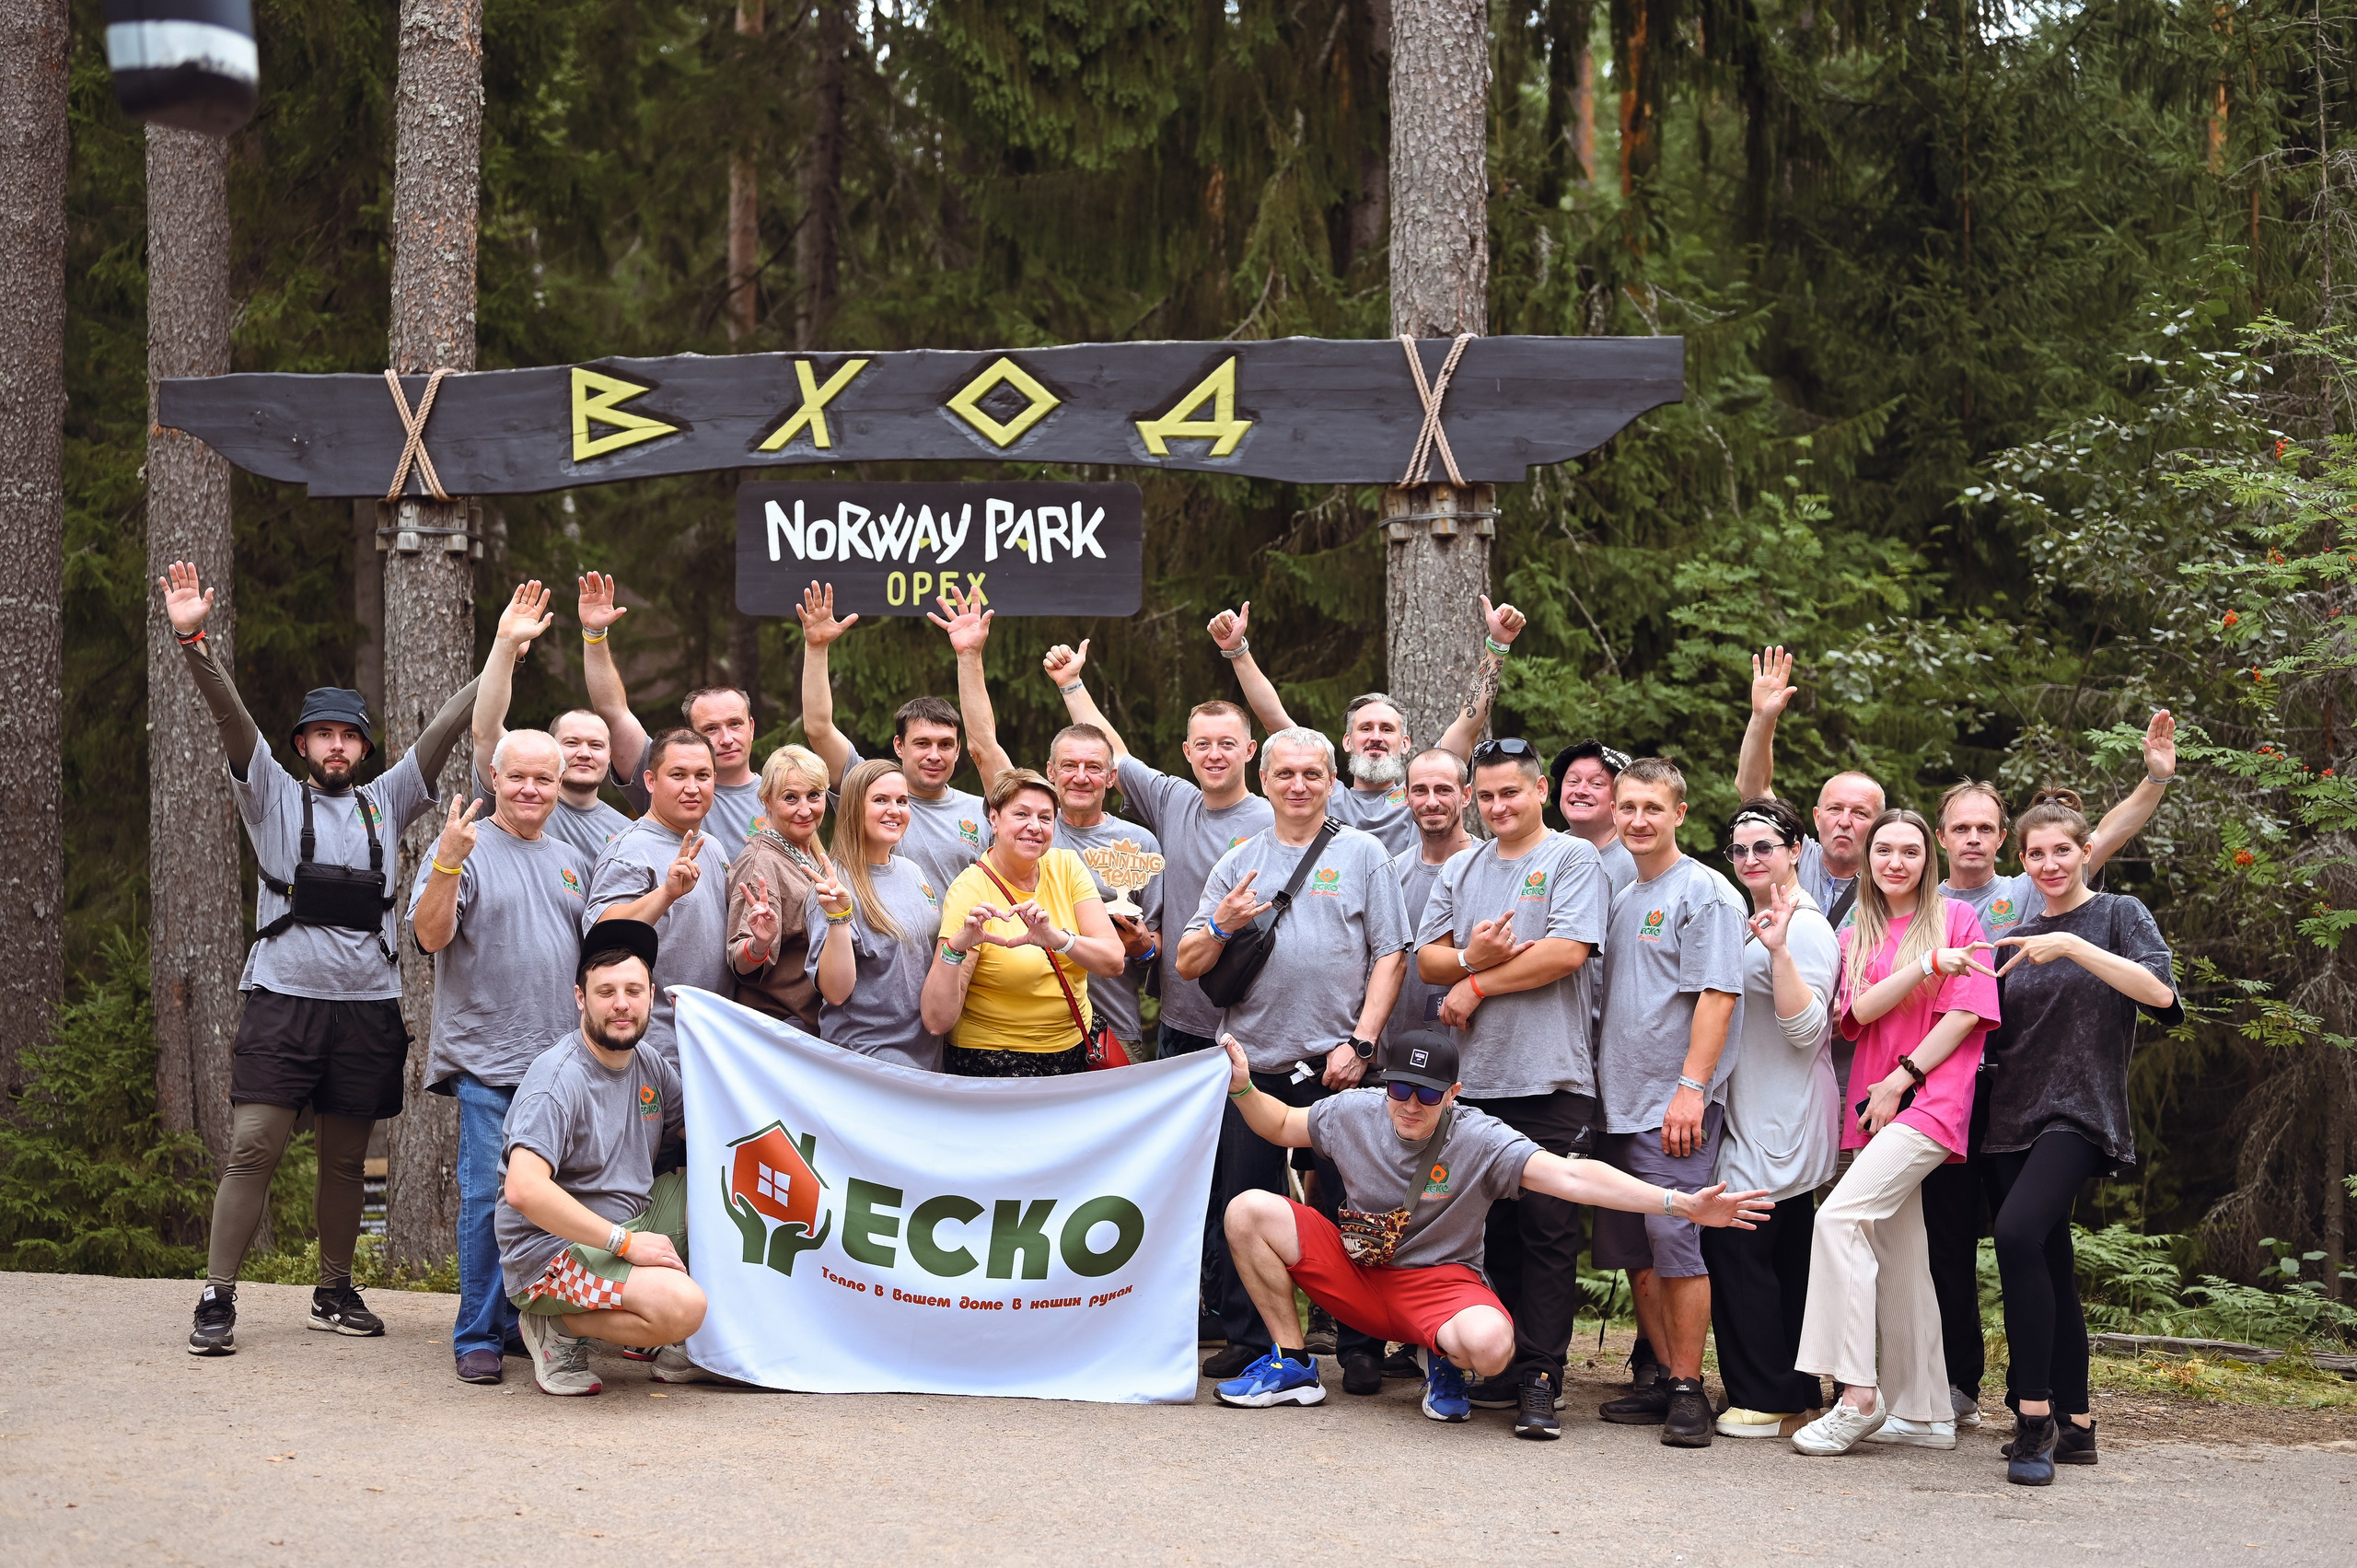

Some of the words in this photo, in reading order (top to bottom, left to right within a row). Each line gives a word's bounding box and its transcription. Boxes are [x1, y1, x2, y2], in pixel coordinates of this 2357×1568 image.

[572, 356, 1252, 461] ВХОД
[984, 498, 1107, 564] PARK
[1084, 850, 1161, 871] WINNING
[821, 1266, 866, 1292] Тепло
[958, 1295, 1004, 1310] доме
[1030, 1297, 1082, 1309] наших
[1088, 1284, 1133, 1307] руках
